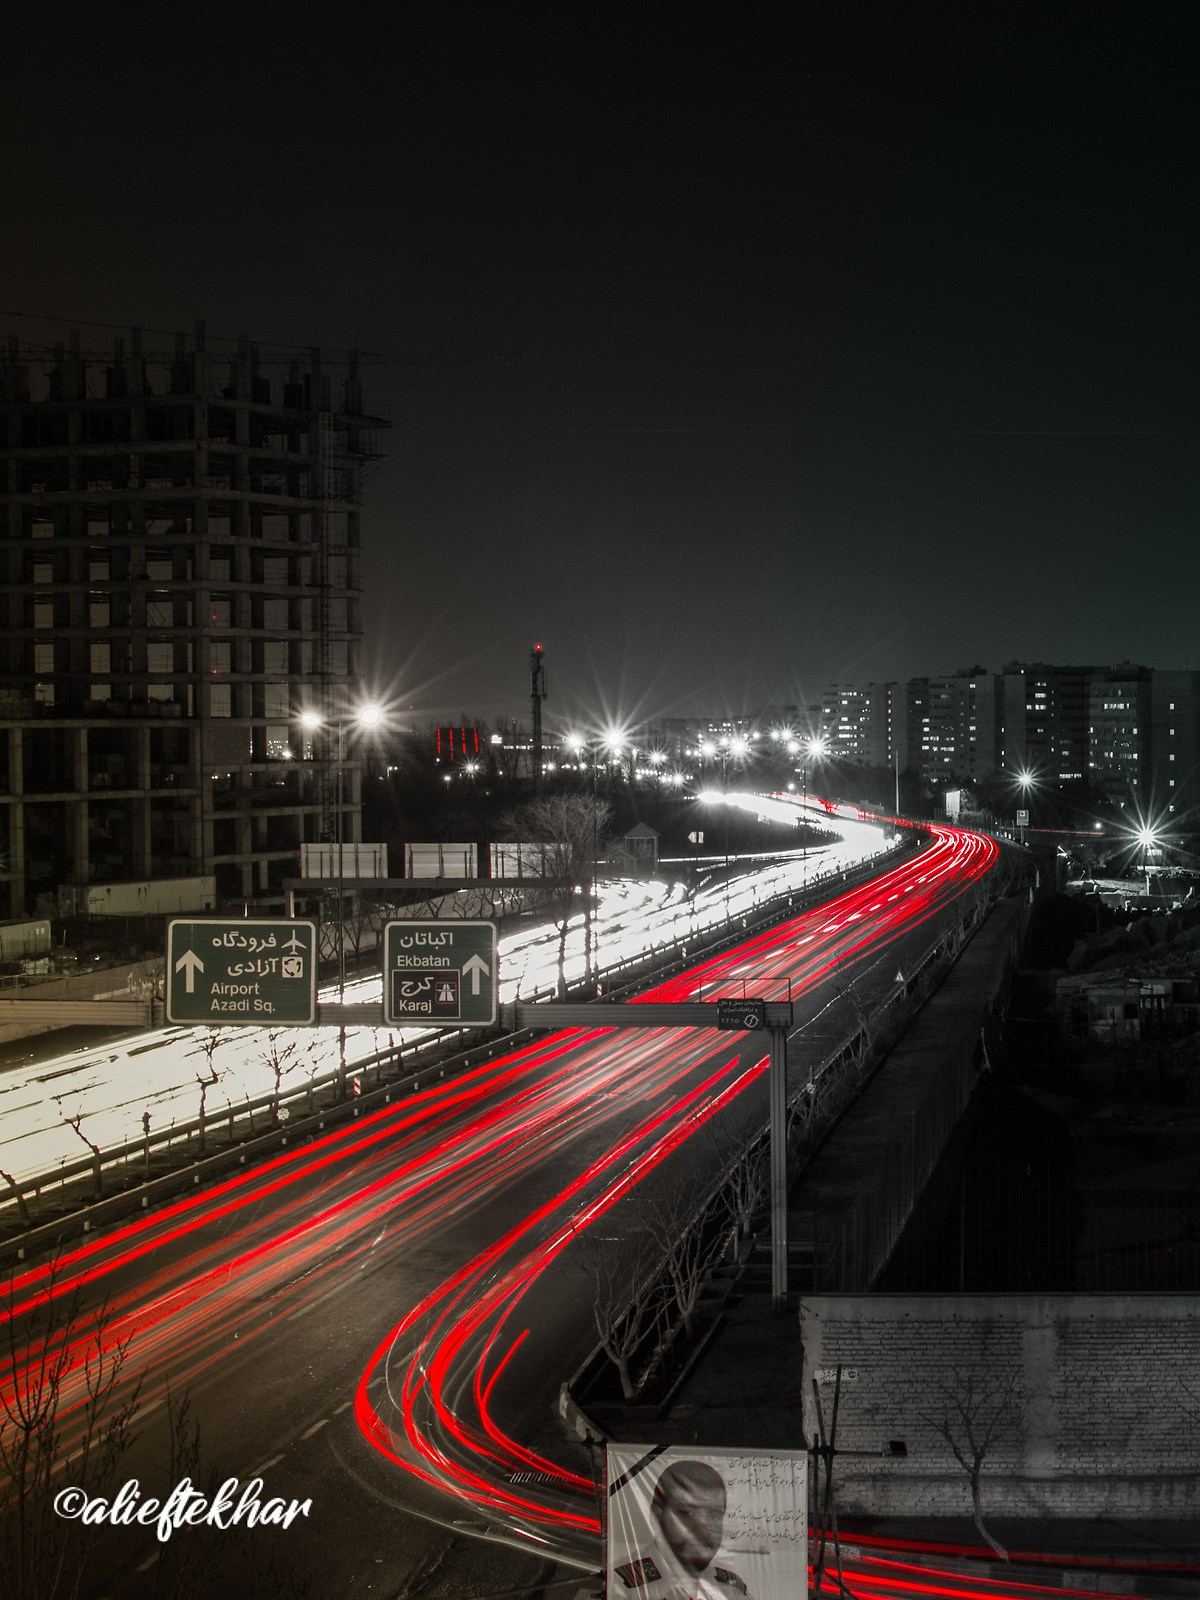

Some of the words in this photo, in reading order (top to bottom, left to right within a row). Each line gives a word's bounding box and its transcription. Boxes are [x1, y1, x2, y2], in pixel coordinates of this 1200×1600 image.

[212, 931, 277, 953] فرودگاه
[400, 932, 453, 948] اکباتان
[227, 957, 280, 977] آزادی
[397, 955, 450, 967] Ekbatan
[211, 982, 260, 997] Airport
[401, 976, 434, 997] کرج
[210, 998, 250, 1011] Azadi
[253, 998, 276, 1014] Sq.
[399, 999, 432, 1013] Karaj
